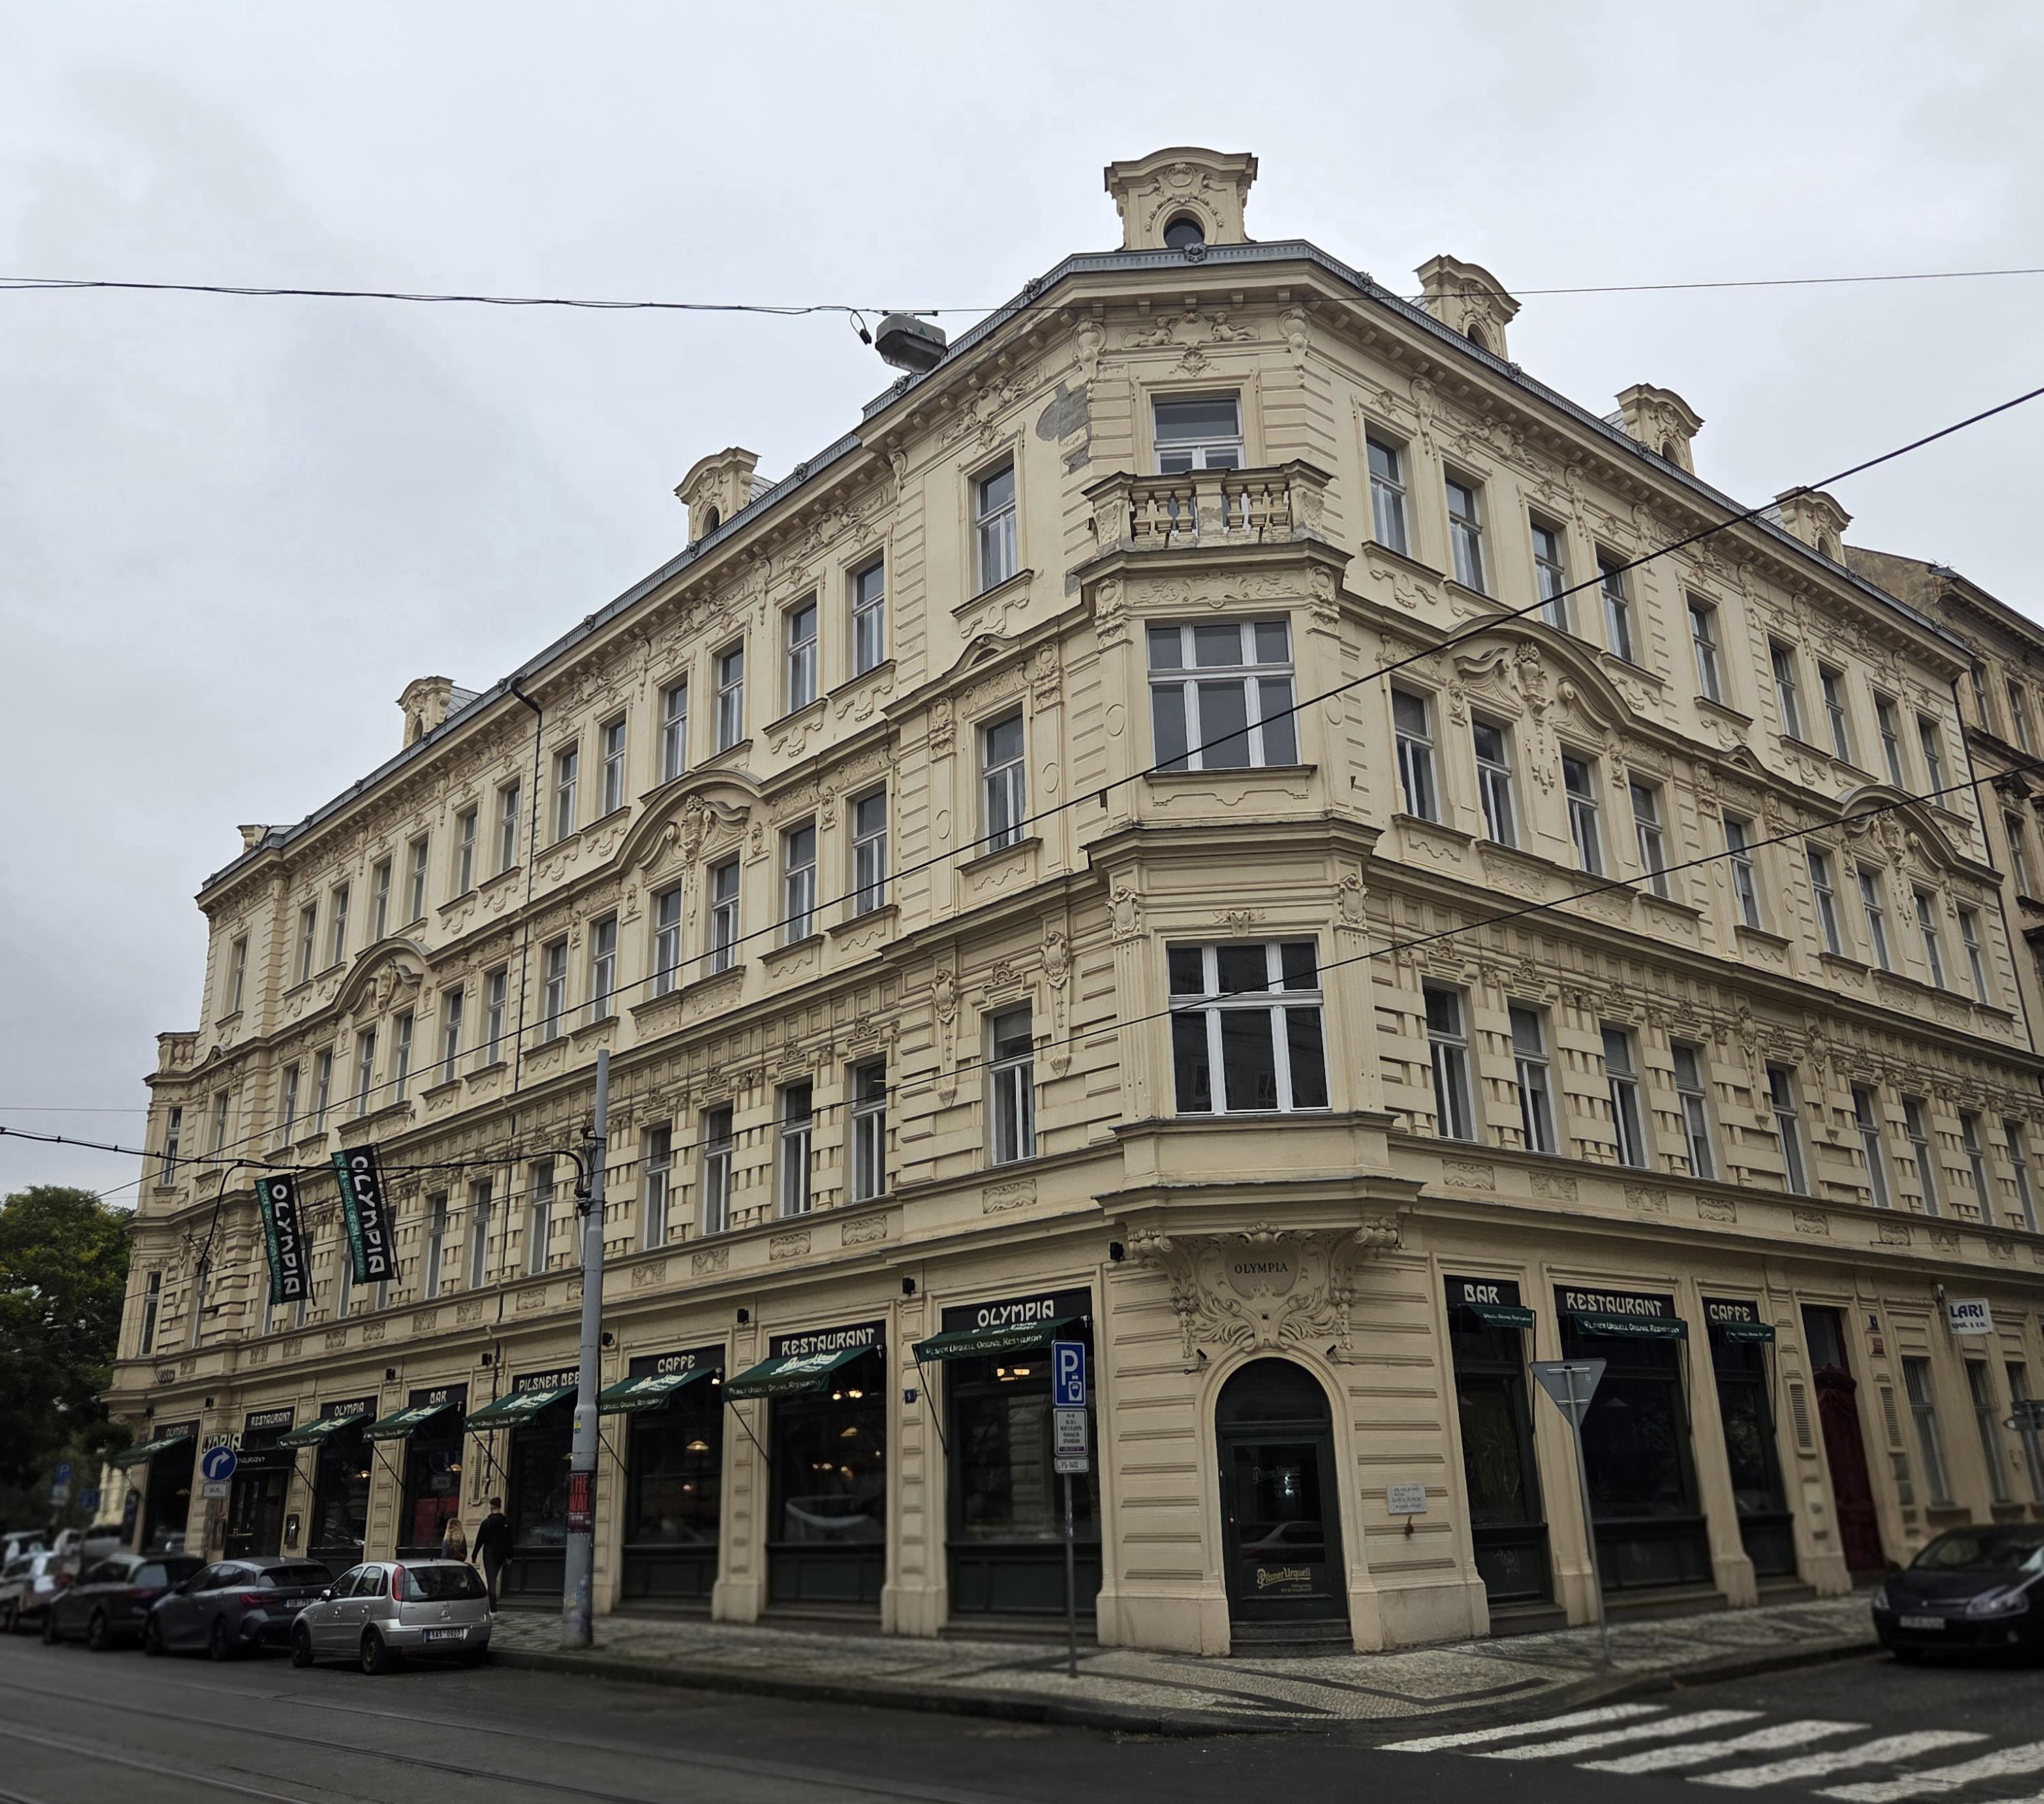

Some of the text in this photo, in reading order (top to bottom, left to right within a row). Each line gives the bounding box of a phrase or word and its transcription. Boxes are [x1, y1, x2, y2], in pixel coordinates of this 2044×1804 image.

[351, 1155, 385, 1274] OLYMPIA
[272, 1184, 300, 1294] OLYMPIA
[1234, 1262, 1288, 1274] OLYMPIA
[1464, 1284, 1500, 1304] BAR
[1566, 1292, 1662, 1316] RESTAURANT
[977, 1299, 1055, 1328] OLYMPIA
[1709, 1304, 1751, 1322] CAFFE
[1949, 1304, 1984, 1318] LARI
[781, 1327, 875, 1356] RESTAURANT
[657, 1354, 696, 1373] CAFFE
[1061, 1350, 1079, 1386] P
[518, 1371, 580, 1393] PILSNER BEE
[429, 1390, 447, 1404] BAR
[906, 1390, 912, 1401] 9
[250, 1411, 292, 1427] RESTAURANT
[334, 1401, 365, 1417] OLYMPIA
[1256, 1568, 1284, 1590] Pilsner
[1283, 1566, 1311, 1582] Urquell
